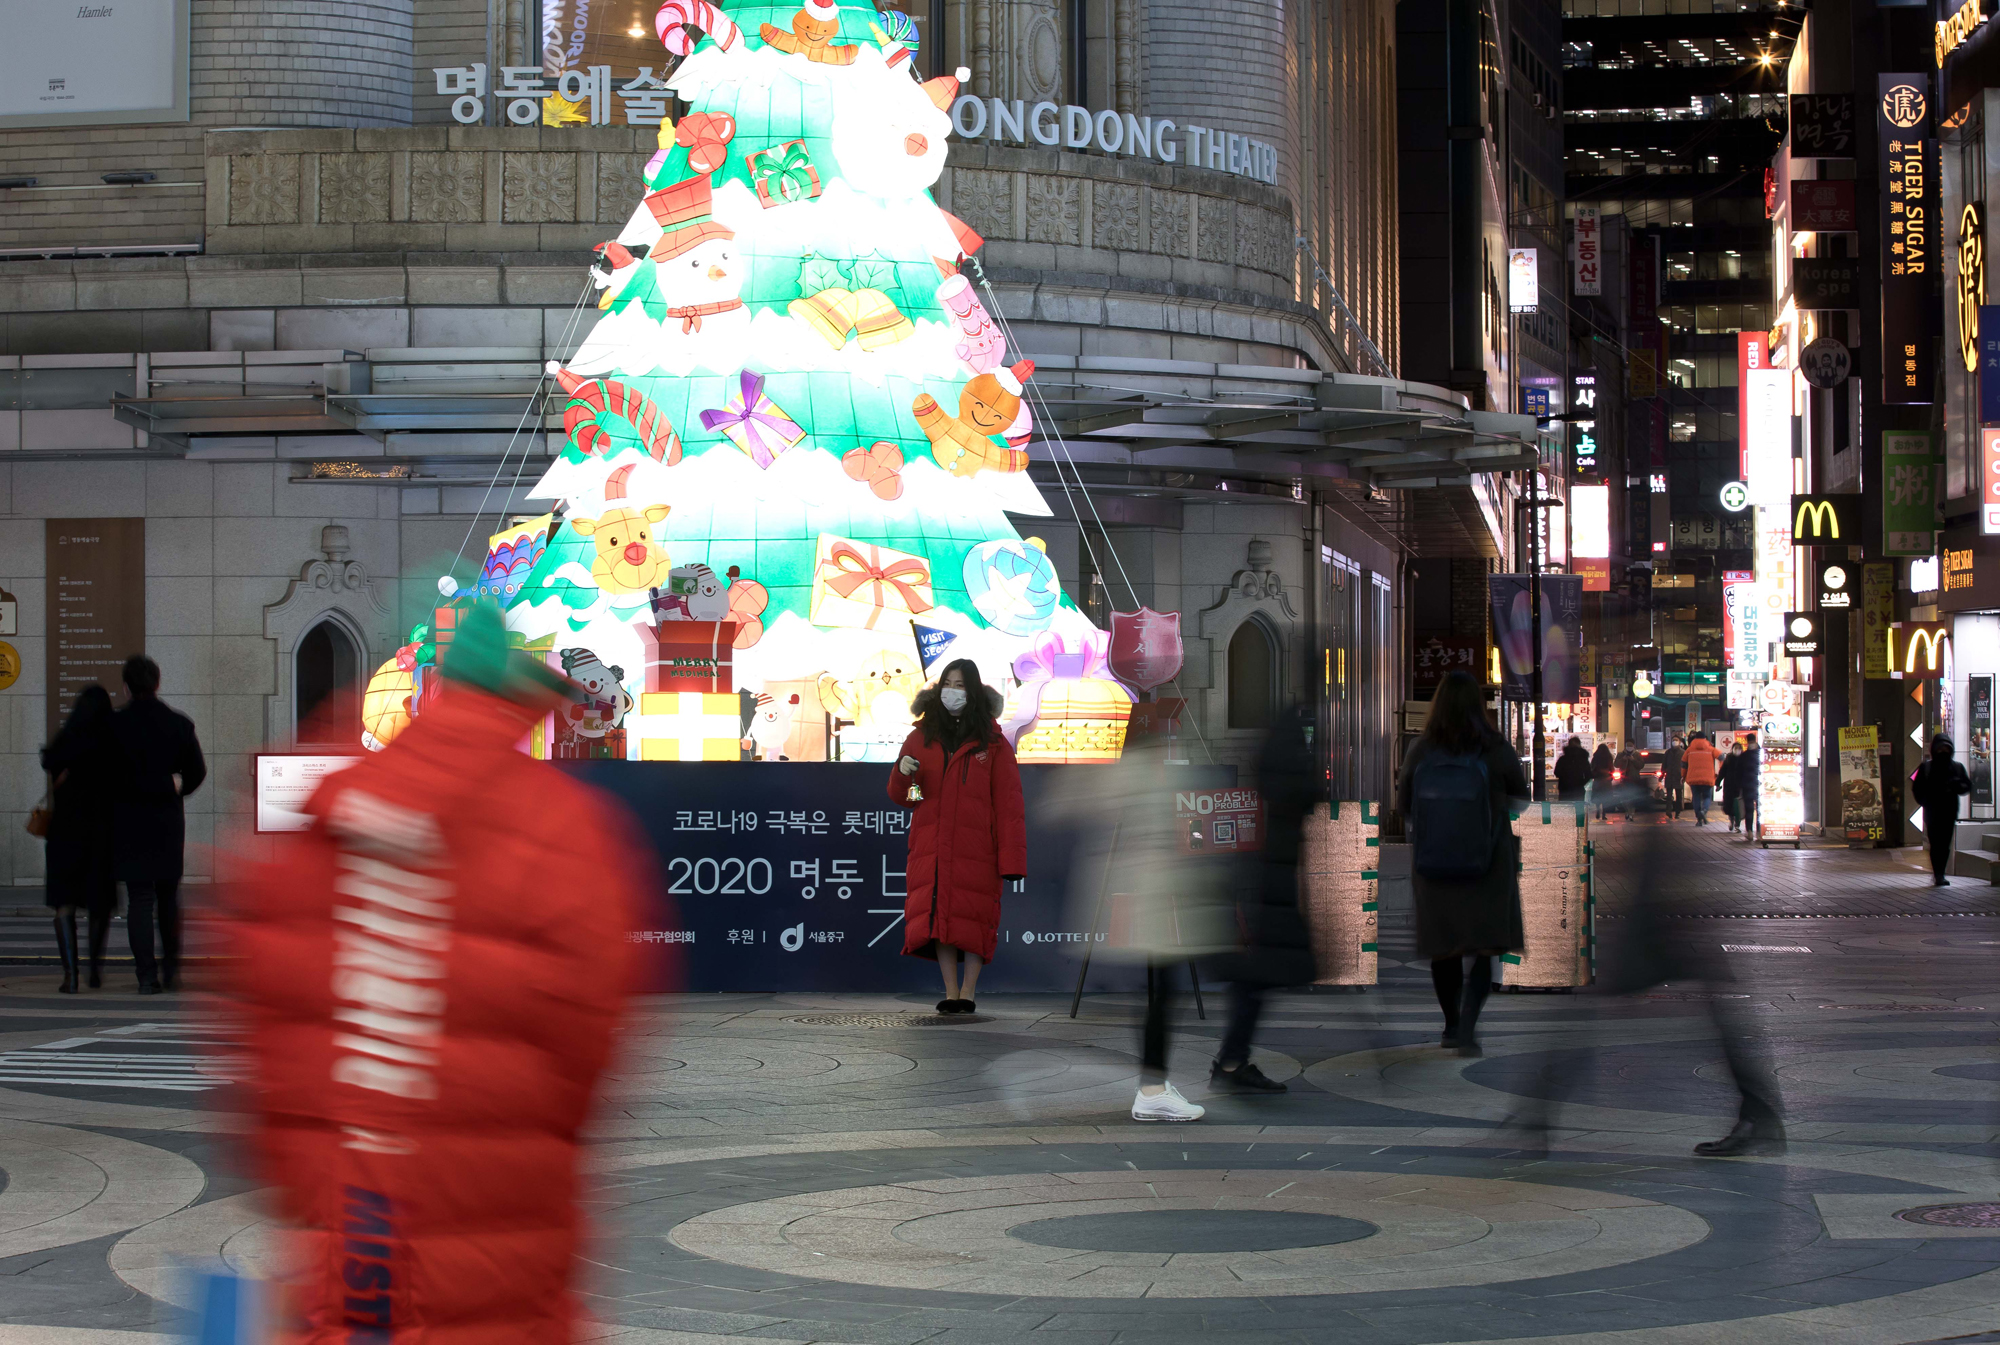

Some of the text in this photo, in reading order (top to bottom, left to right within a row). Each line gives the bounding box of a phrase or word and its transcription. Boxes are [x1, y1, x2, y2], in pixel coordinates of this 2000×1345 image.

[76, 5, 113, 18] Hamlet
[432, 63, 675, 126] 명동예술
[1793, 96, 1853, 120] 강남
[1796, 119, 1853, 151] 면옥
[1181, 125, 1279, 187] THEATER
[1797, 184, 1809, 194] 4F
[1579, 208, 1595, 217] 우진
[1905, 140, 1925, 275] TIGER SUGAR
[1577, 218, 1598, 283] 부동산
[1801, 267, 1851, 280] Korea
[1747, 341, 1759, 369] RED
[1904, 344, 1917, 387] 명동점
[1575, 376, 1595, 385] STAR
[1894, 440, 1923, 451] おかゆ
[1576, 456, 1596, 466] Cafe
[1888, 464, 1929, 507] 粥
[921, 631, 946, 645] VISIT
[1742, 606, 1759, 668] 대한곱창
[1132, 618, 1157, 680] 구세군
[672, 656, 721, 669] MERRY
[670, 670, 722, 679] MEDIHEAL
[1765, 687, 1790, 711] 약
[1844, 727, 1871, 736] MONEY
[1176, 791, 1258, 814] NO CASH?
[1214, 801, 1258, 809] PROBLEM
[673, 810, 758, 834] 코로나19
[765, 810, 830, 834] 극복은
[1868, 827, 1883, 840] 5F
[668, 857, 773, 894] 2020
[790, 858, 864, 900] 명동
[1560, 870, 1569, 916] Smart-Q
[727, 929, 845, 945] 후원 서울중구
[1037, 932, 1082, 942] LOTTE
